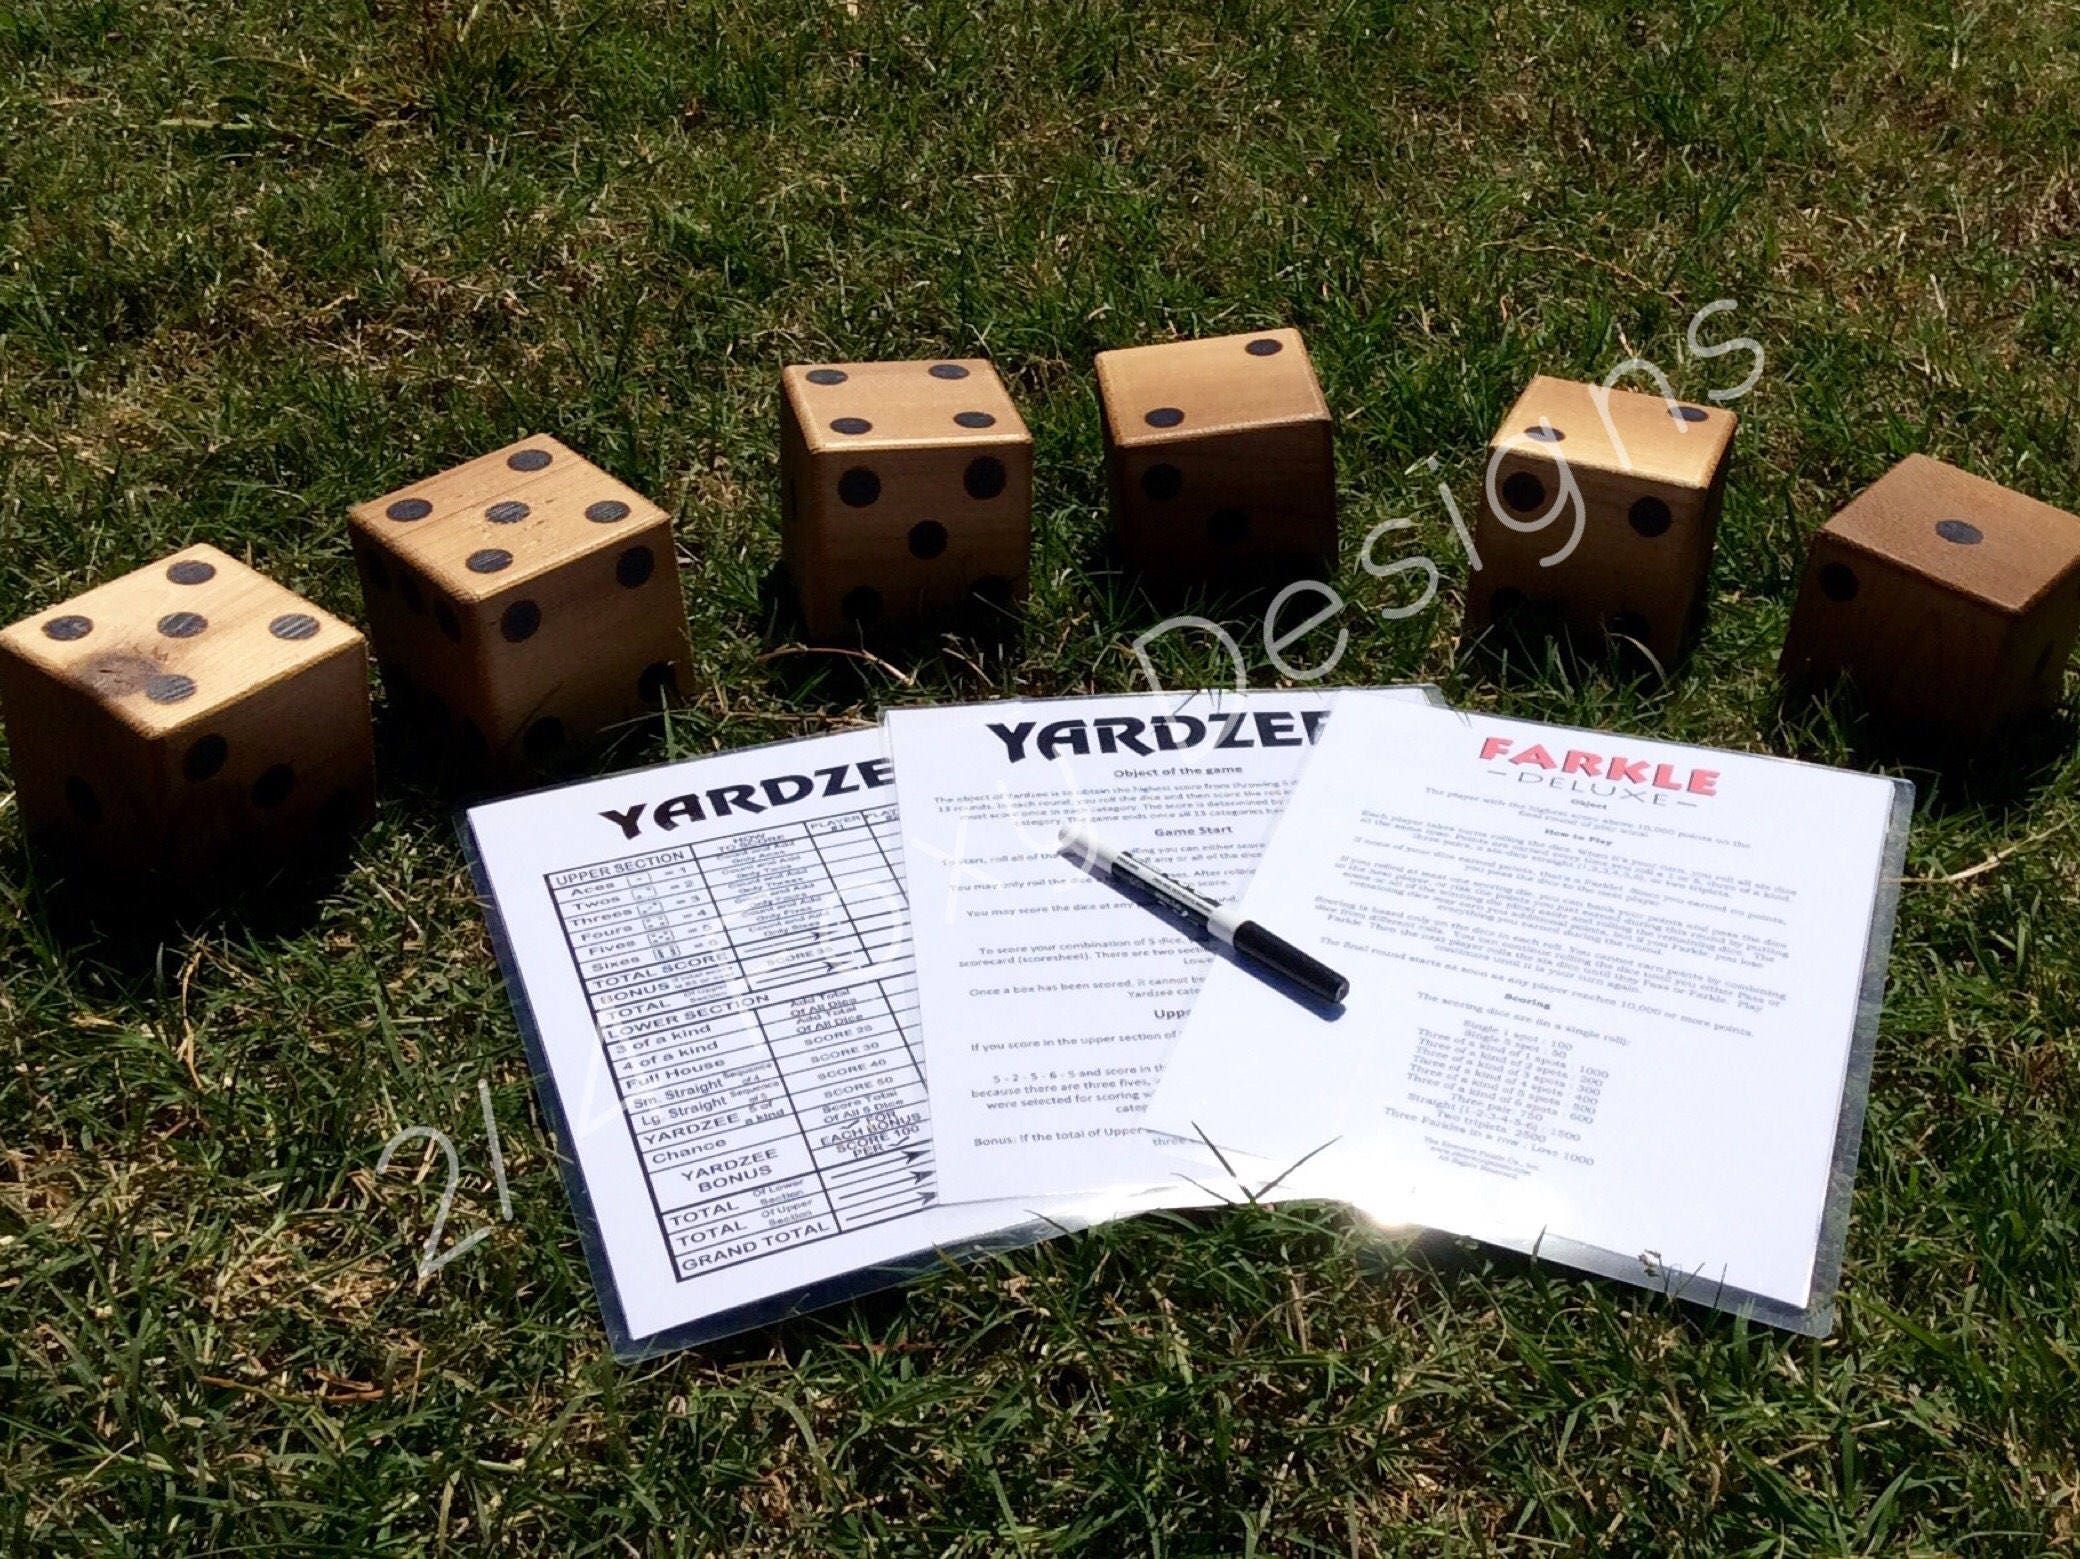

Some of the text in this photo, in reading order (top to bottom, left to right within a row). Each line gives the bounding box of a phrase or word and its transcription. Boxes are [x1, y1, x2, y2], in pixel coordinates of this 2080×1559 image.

[1114, 767, 1242, 778] Object of the game
[1479, 737, 1720, 797] FARKLE
[1518, 771, 1668, 806] DELUXE
[1154, 826, 1233, 837] Game Start
[556, 850, 685, 886] UPPER SECTION
[571, 882, 615, 897] Aces
[573, 896, 621, 911] Twos
[570, 909, 632, 927] Threes
[581, 925, 633, 942] Fours
[588, 940, 636, 956] Fives
[979, 947, 994, 955] To
[997, 946, 1028, 954] score
[1030, 944, 1056, 953] your
[1059, 940, 1131, 950] combination
[1133, 937, 1145, 946] of
[592, 957, 640, 972] Sixes
[592, 969, 656, 989] TOTAL
[661, 949, 727, 973] SCORE
[959, 955, 1015, 967] scorecard
[600, 982, 670, 1004] BONUS
[969, 988, 1000, 997] Once
[1013, 986, 1034, 994] box
[1037, 984, 1058, 992] has
[1060, 983, 1090, 991] been
[1148, 977, 1188, 986] cannot
[609, 1000, 671, 1019] TOTAL
[1504, 993, 1551, 1010] Scoring
[607, 990, 770, 1039] LOWER SECTION
[1417, 991, 1439, 1002] The
[1486, 1007, 1510, 1018] dice
[1565, 1026, 1600, 1039] single
[615, 1021, 711, 1054] 3 of a kind
[804, 1029, 852, 1046] SCORE
[971, 1043, 979, 1052] If
[982, 1043, 1005, 1052] you
[1008, 1041, 1041, 1049] score
[1057, 1038, 1077, 1046] the
[1080, 1036, 1115, 1045] upper
[1119, 1033, 1162, 1042] section
[1164, 1030, 1177, 1039] of
[623, 1040, 718, 1070] 4 of a kind
[811, 1046, 859, 1064] SCORE
[626, 1054, 725, 1089] Full House
[817, 1063, 866, 1080] SCORE
[665, 1078, 723, 1101] Straight
[824, 1081, 873, 1099] SCORE
[971, 1088, 1021, 1098] because
[1024, 1085, 1057, 1094] there
[1061, 1083, 1080, 1091] are
[1083, 1081, 1116, 1090] three
[1407, 1072, 1441, 1086] Three
[1443, 1082, 1456, 1090] of
[1468, 1087, 1497, 1101] kind
[1499, 1094, 1513, 1104] of
[1569, 1113, 1594, 1124] 600
[1451, 1093, 1484, 1106] Three
[668, 1096, 728, 1119] Straight
[986, 1092, 1140, 1110] were selected for scoring
[644, 1112, 739, 1145] YARDZEE
[820, 1113, 923, 1148] EACH BONUS
[1031, 1133, 1052, 1142] the
[1055, 1130, 1085, 1140] total
[1088, 1128, 1100, 1137] of
[1104, 1127, 1143, 1137] Upper
[1385, 1106, 1418, 1121] Three
[1564, 1152, 1594, 1166] 1000
[1437, 1108, 1461, 1122] Two
[1515, 1129, 1546, 1143] 2500
[833, 1122, 920, 1153] SCORE 100
[652, 1139, 727, 1164] Chance
[850, 1141, 884, 1159] PER
[681, 1149, 778, 1181] YARDZEE
[698, 1165, 772, 1193] BONUS
[669, 1201, 739, 1226] TOTAL
[676, 1221, 747, 1247] TOTAL
[682, 1222, 830, 1271] GRAND TOTAL
